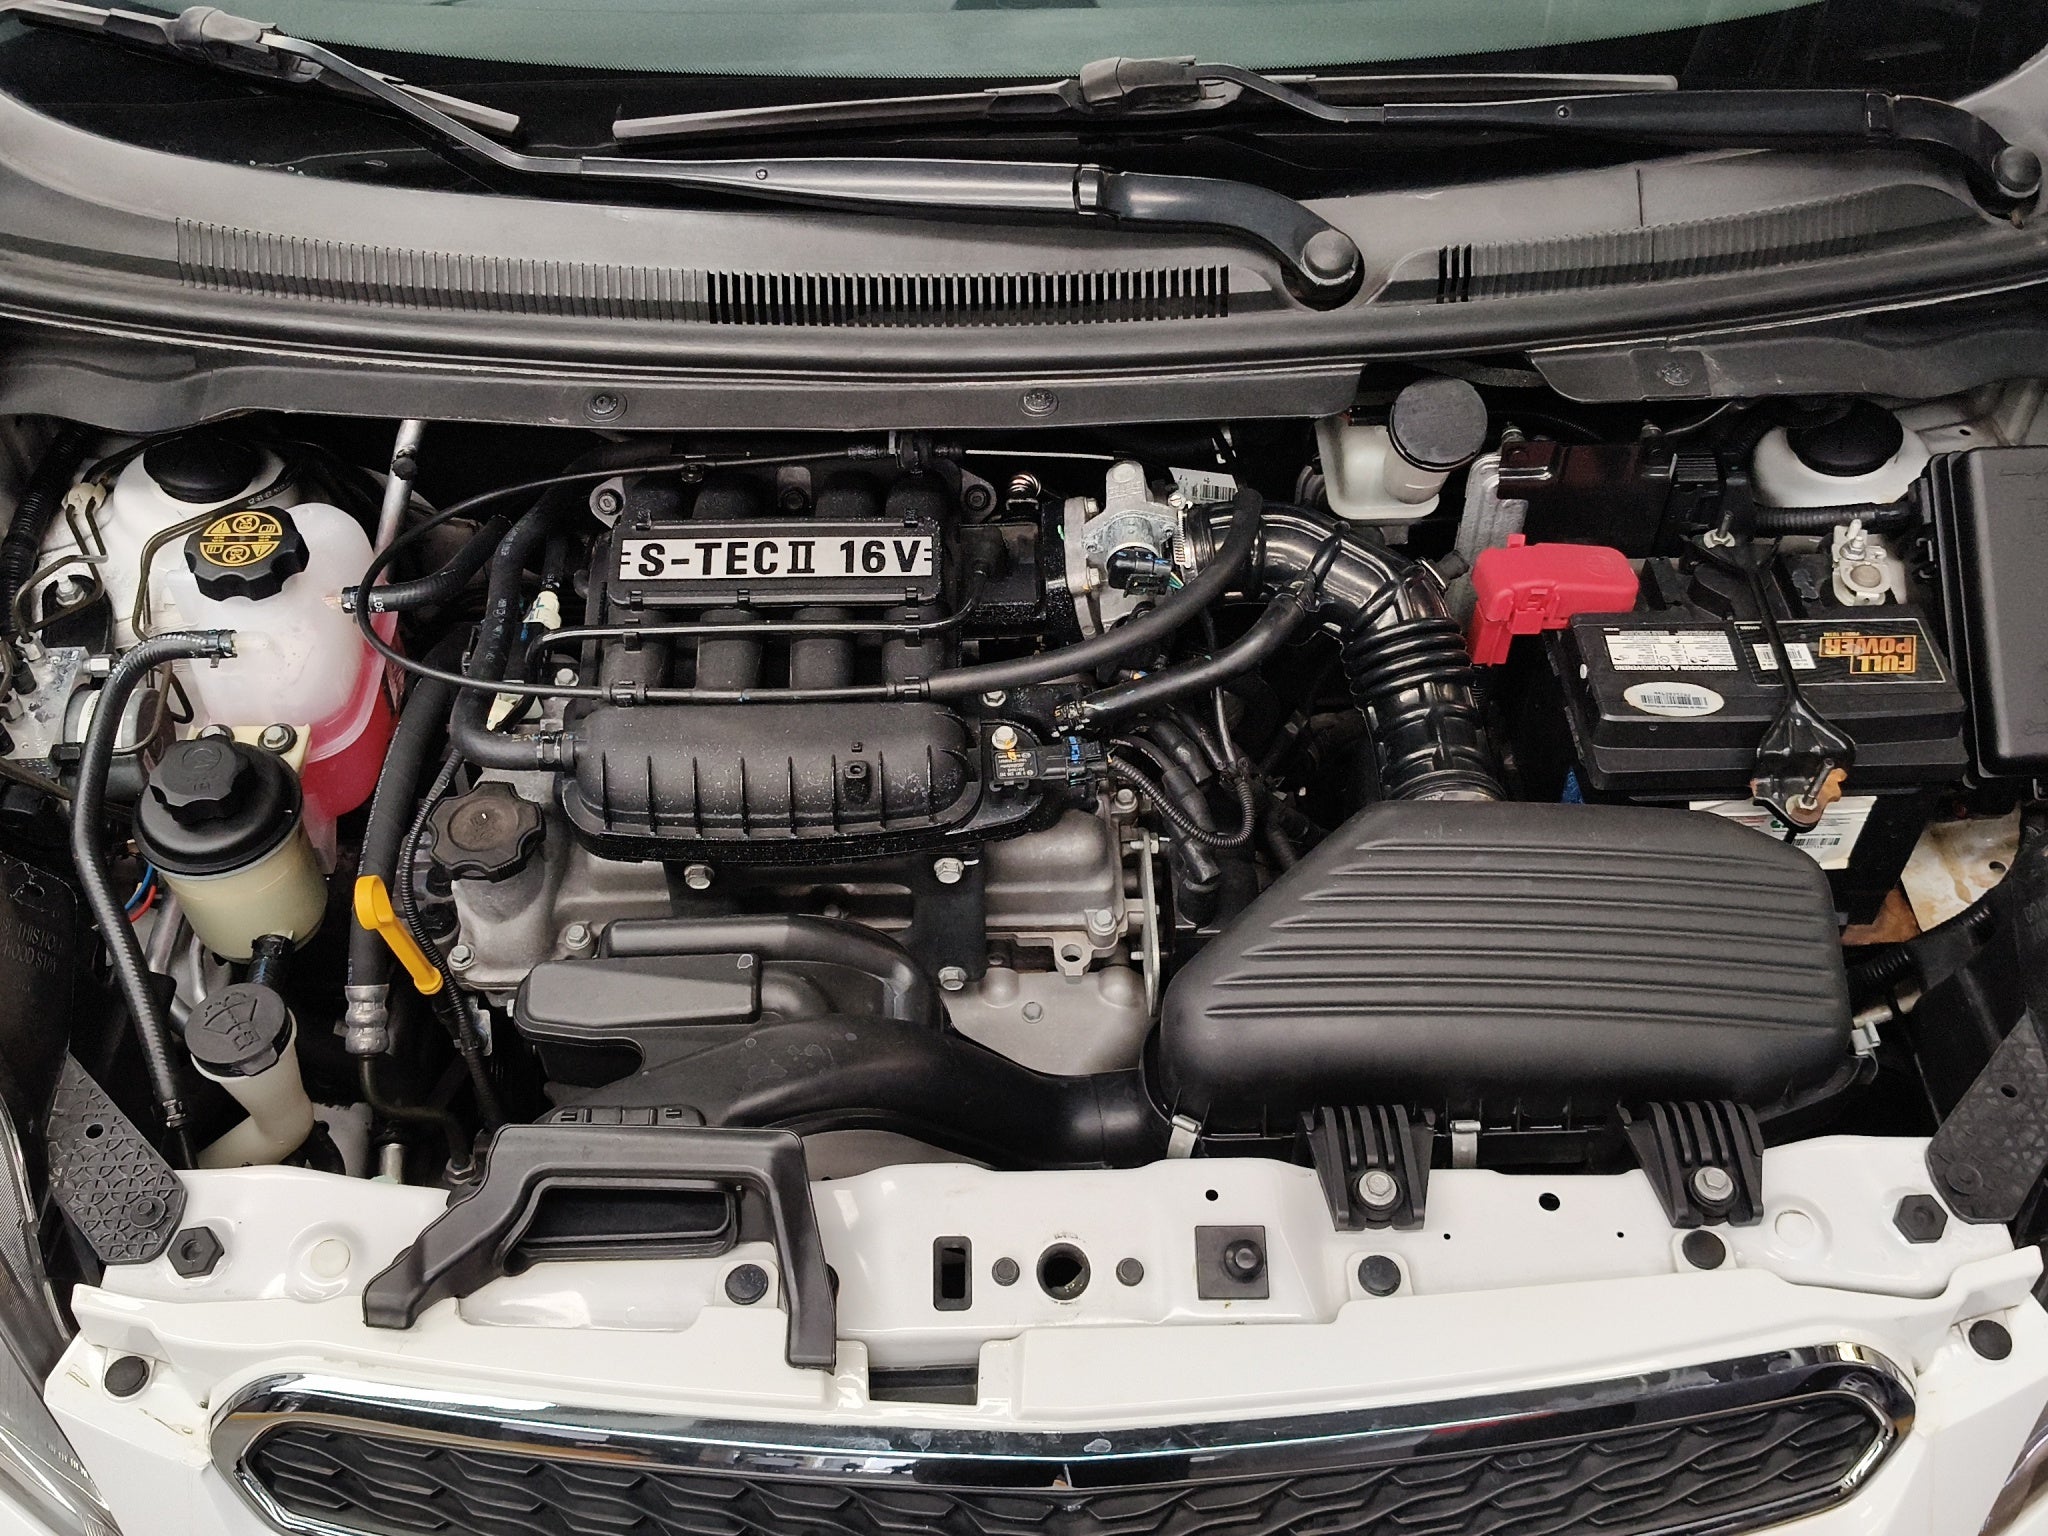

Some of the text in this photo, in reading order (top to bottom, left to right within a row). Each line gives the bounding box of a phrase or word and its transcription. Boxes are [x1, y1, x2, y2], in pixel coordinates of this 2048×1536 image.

[839, 540, 921, 573] 16V
[1825, 638, 1912, 655] POWER
[1856, 654, 1911, 672] FULL
